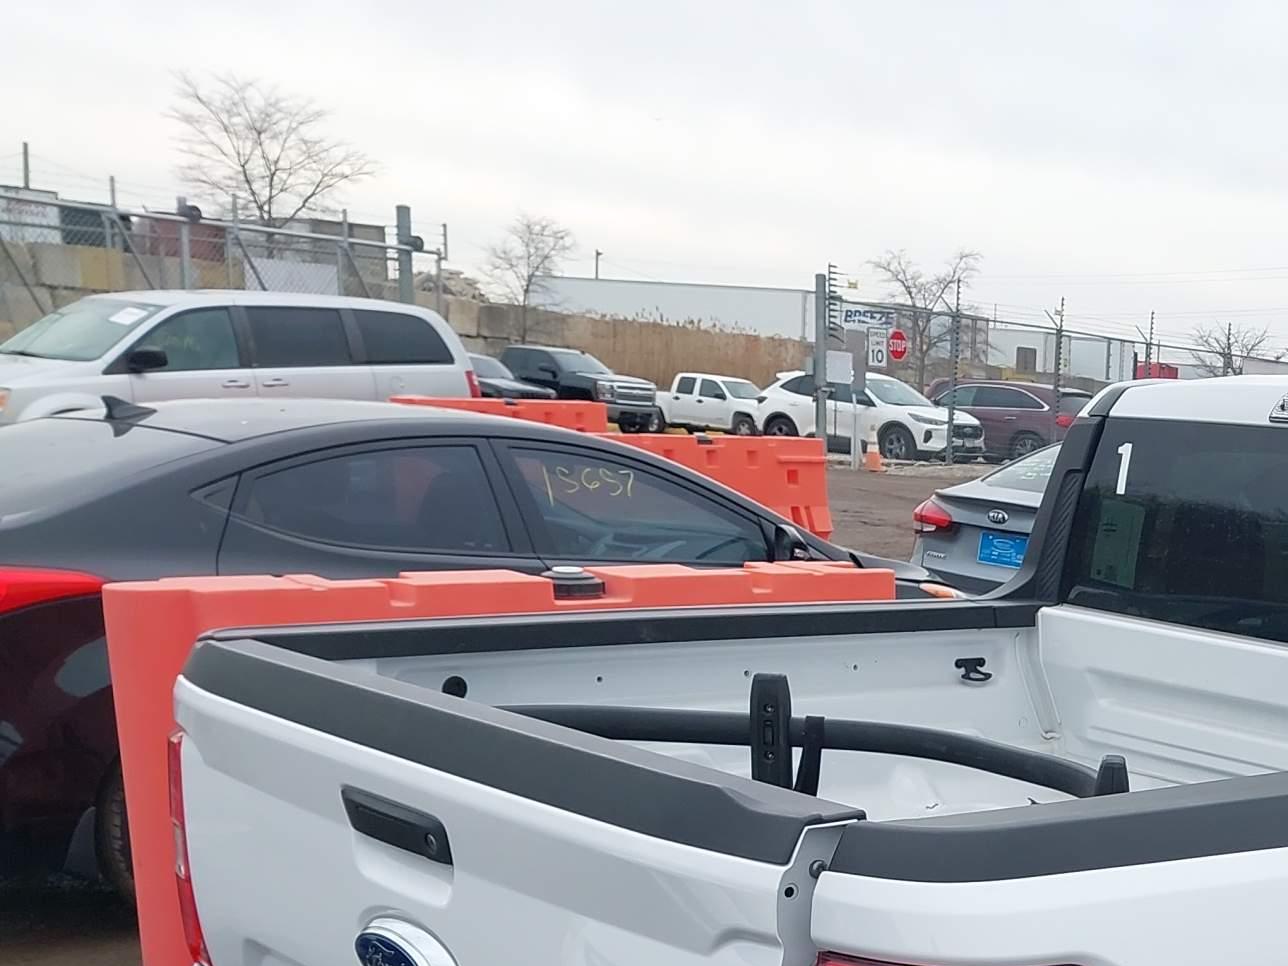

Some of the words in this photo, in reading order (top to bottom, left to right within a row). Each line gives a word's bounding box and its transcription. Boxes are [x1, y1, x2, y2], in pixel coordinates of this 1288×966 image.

[889, 340, 906, 351] STOP
[871, 349, 884, 363] 10
[1116, 442, 1133, 494] 1
